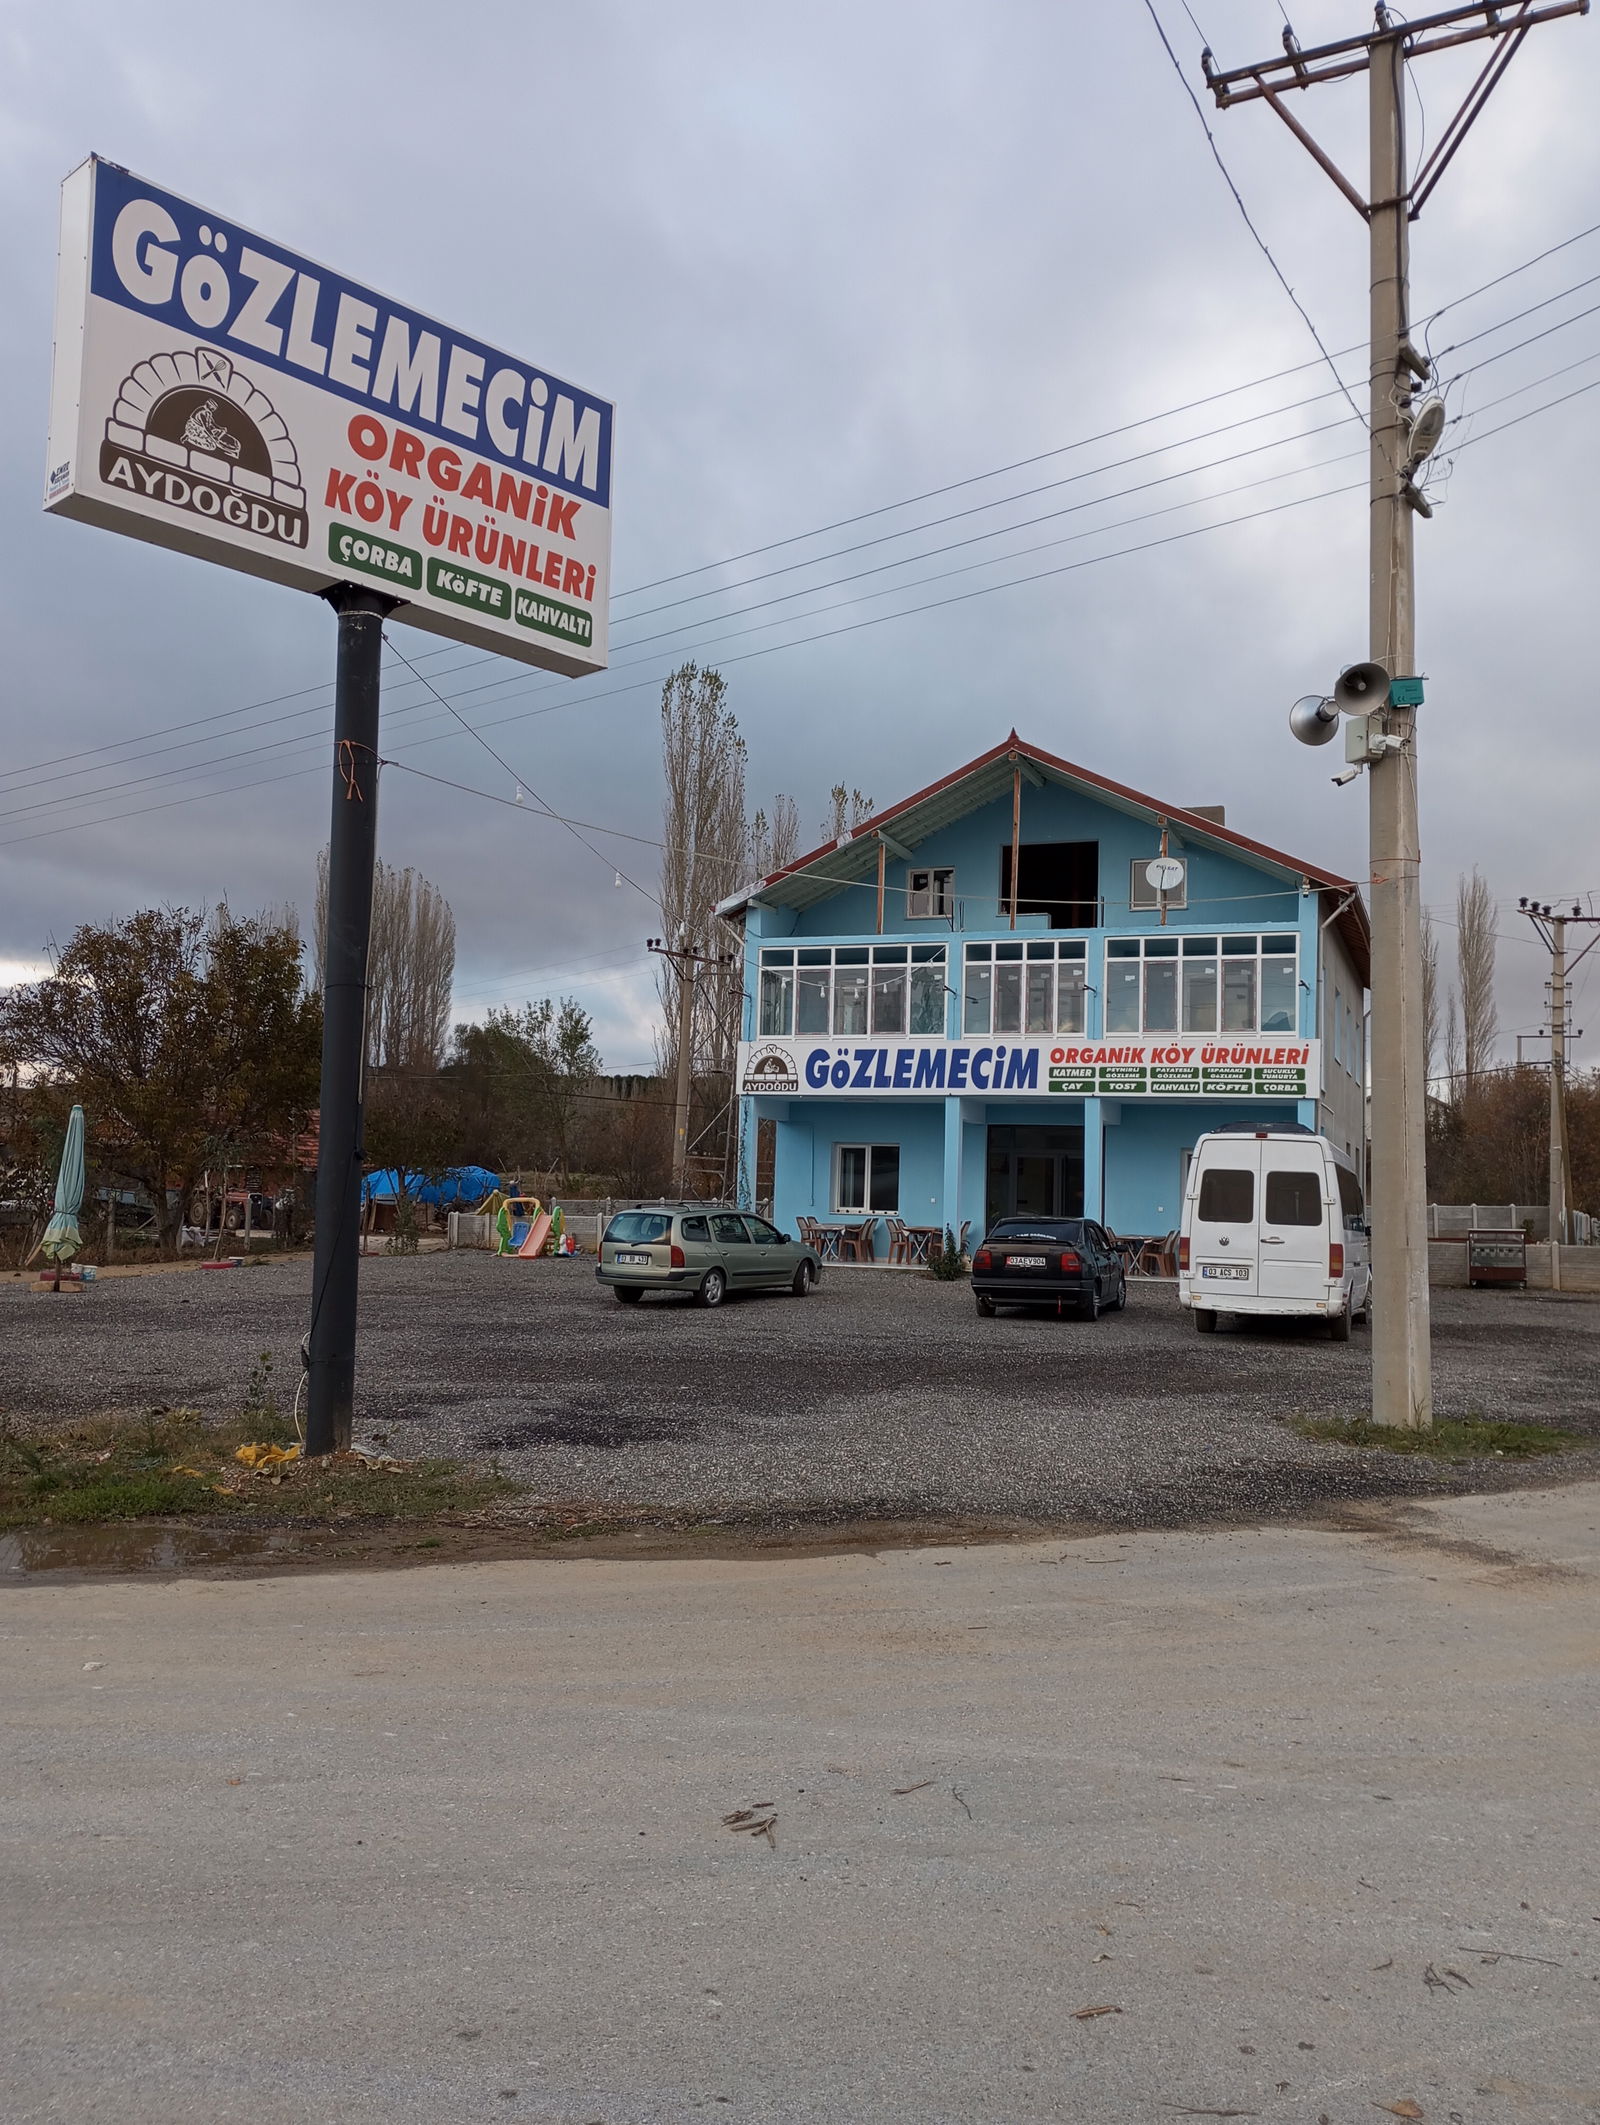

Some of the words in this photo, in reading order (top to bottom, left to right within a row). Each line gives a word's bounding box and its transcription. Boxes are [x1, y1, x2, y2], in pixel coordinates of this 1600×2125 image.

[107, 456, 301, 544] AYDOĞDU
[324, 467, 413, 532] KÖY
[339, 535, 413, 578] ÇORBA
[517, 597, 591, 638] KAHVALTI
[1150, 1043, 1196, 1064] KÖY
[1201, 1043, 1310, 1065] ÜRÜNLERİ
[1052, 1069, 1092, 1077] KATMER
[744, 1081, 797, 1091] AYDOĞDU
[1061, 1083, 1083, 1091] ÇAY
[1152, 1083, 1199, 1091] KAHVALTI
[1206, 1082, 1249, 1091] KÖFTE
[1263, 1084, 1299, 1092] ÇORBA
[1235, 1269, 1247, 1277] 103
